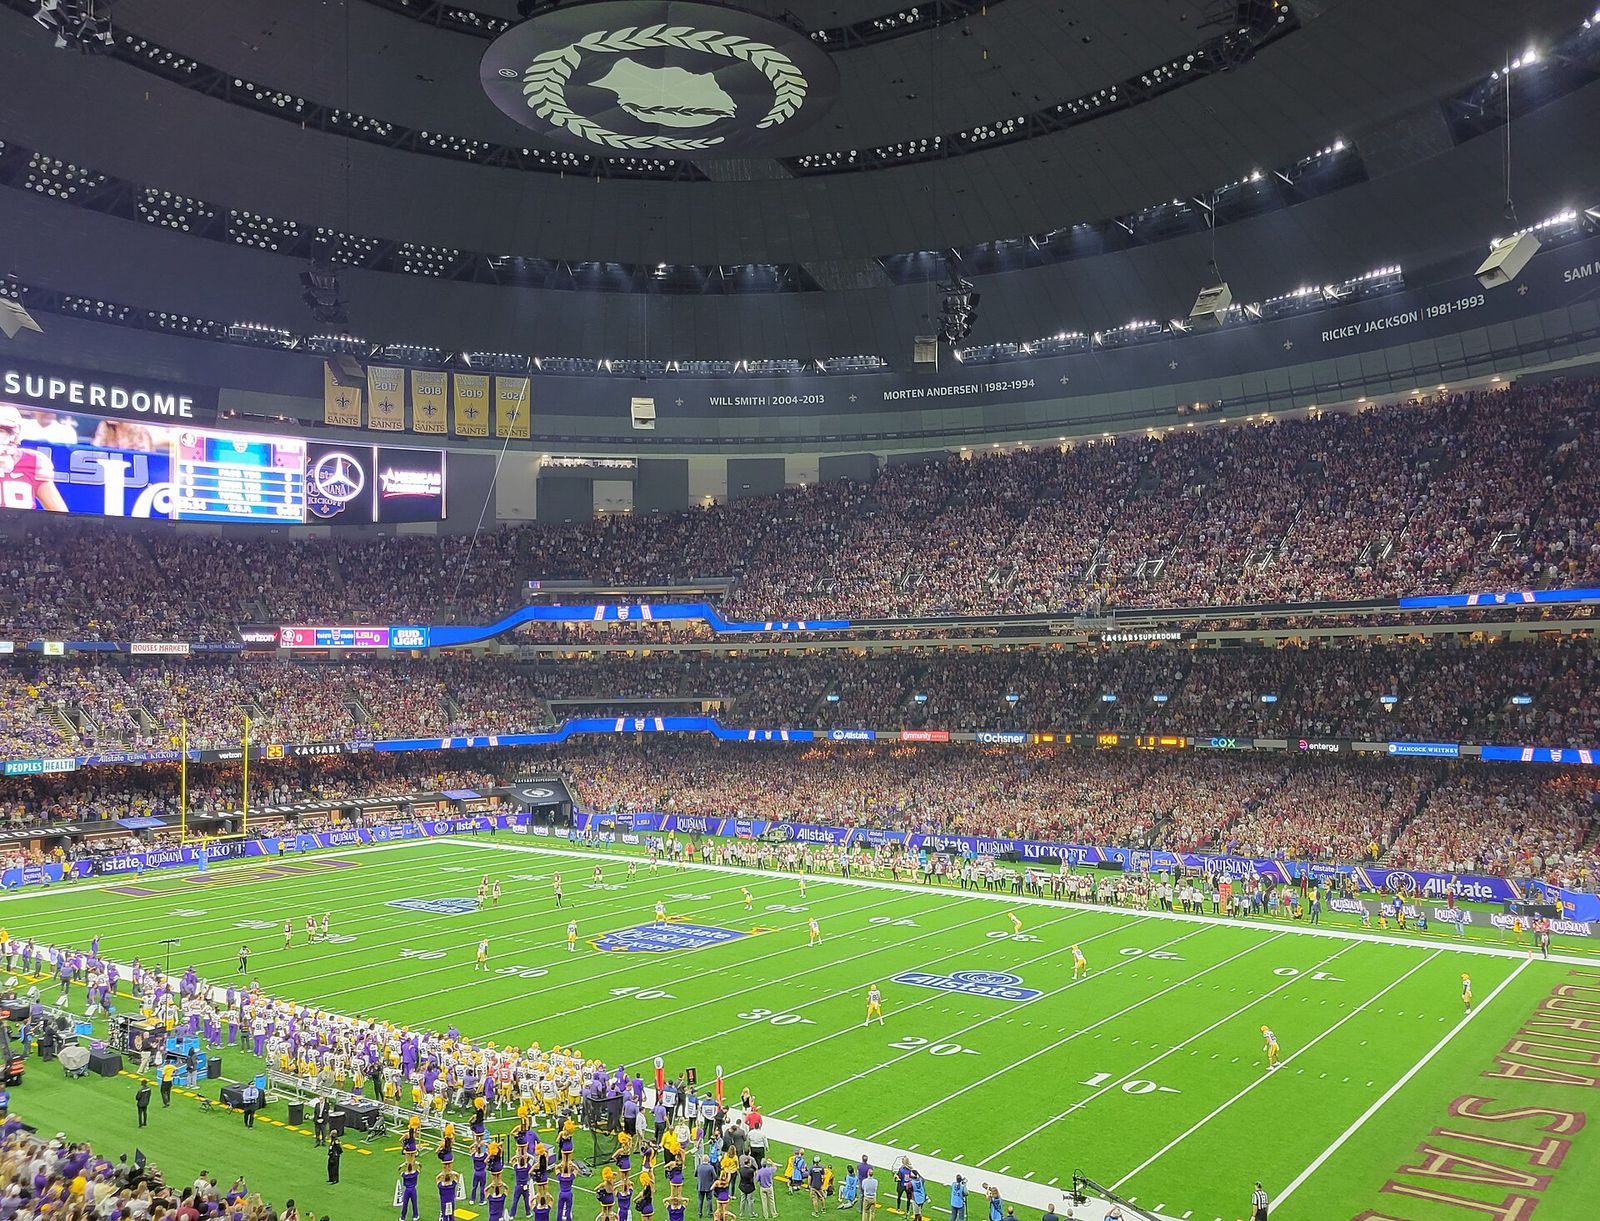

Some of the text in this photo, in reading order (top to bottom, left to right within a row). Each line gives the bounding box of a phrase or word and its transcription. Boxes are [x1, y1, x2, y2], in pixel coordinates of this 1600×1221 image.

[1564, 266, 1592, 283] SAM
[1321, 294, 1485, 343] RICKEY JACKSON 1981-1993
[375, 382, 398, 392] 2017
[418, 386, 442, 395] 2018
[883, 379, 1035, 401] MORTEN ANDERSEN 1982-1994
[4, 372, 193, 418] SUPERDOME
[460, 389, 484, 398] 2019
[709, 395, 825, 406] WILL SMITH 2004-2013
[327, 415, 359, 426] SAINTS
[370, 420, 403, 429] SAINTS
[414, 424, 446, 432] SAINTS
[456, 426, 487, 435] SAINTS
[498, 429, 528, 437] SAINTS
[242, 632, 274, 642] verizon
[397, 630, 420, 638] BUD
[393, 637, 424, 646] LIGHT
[132, 644, 158, 653] ROUSES
[159, 645, 189, 653] MARKETS
[984, 733, 1024, 743] Ochsner
[1211, 737, 1236, 748] COX
[268, 747, 282, 757] 25
[295, 745, 341, 755] CAESARS
[1308, 743, 1339, 753] entergy
[98, 754, 125, 763] Allstate
[218, 752, 243, 760] verizon
[7, 760, 74, 773] PEOPLES HEALTH
[676, 816, 707, 832] LOUISIANA
[922, 836, 970, 853] Allstate
[976, 839, 1015, 855] LOUISIANA
[146, 850, 184, 867] LOUISIANA
[1024, 844, 1088, 862] KICKOFF
[1204, 857, 1255, 875] LOUISIANA
[897, 975, 1023, 999] Allstate
[737, 1008, 802, 1026] 30
[887, 1036, 963, 1056] 20
[1078, 1072, 1157, 1094] 10
